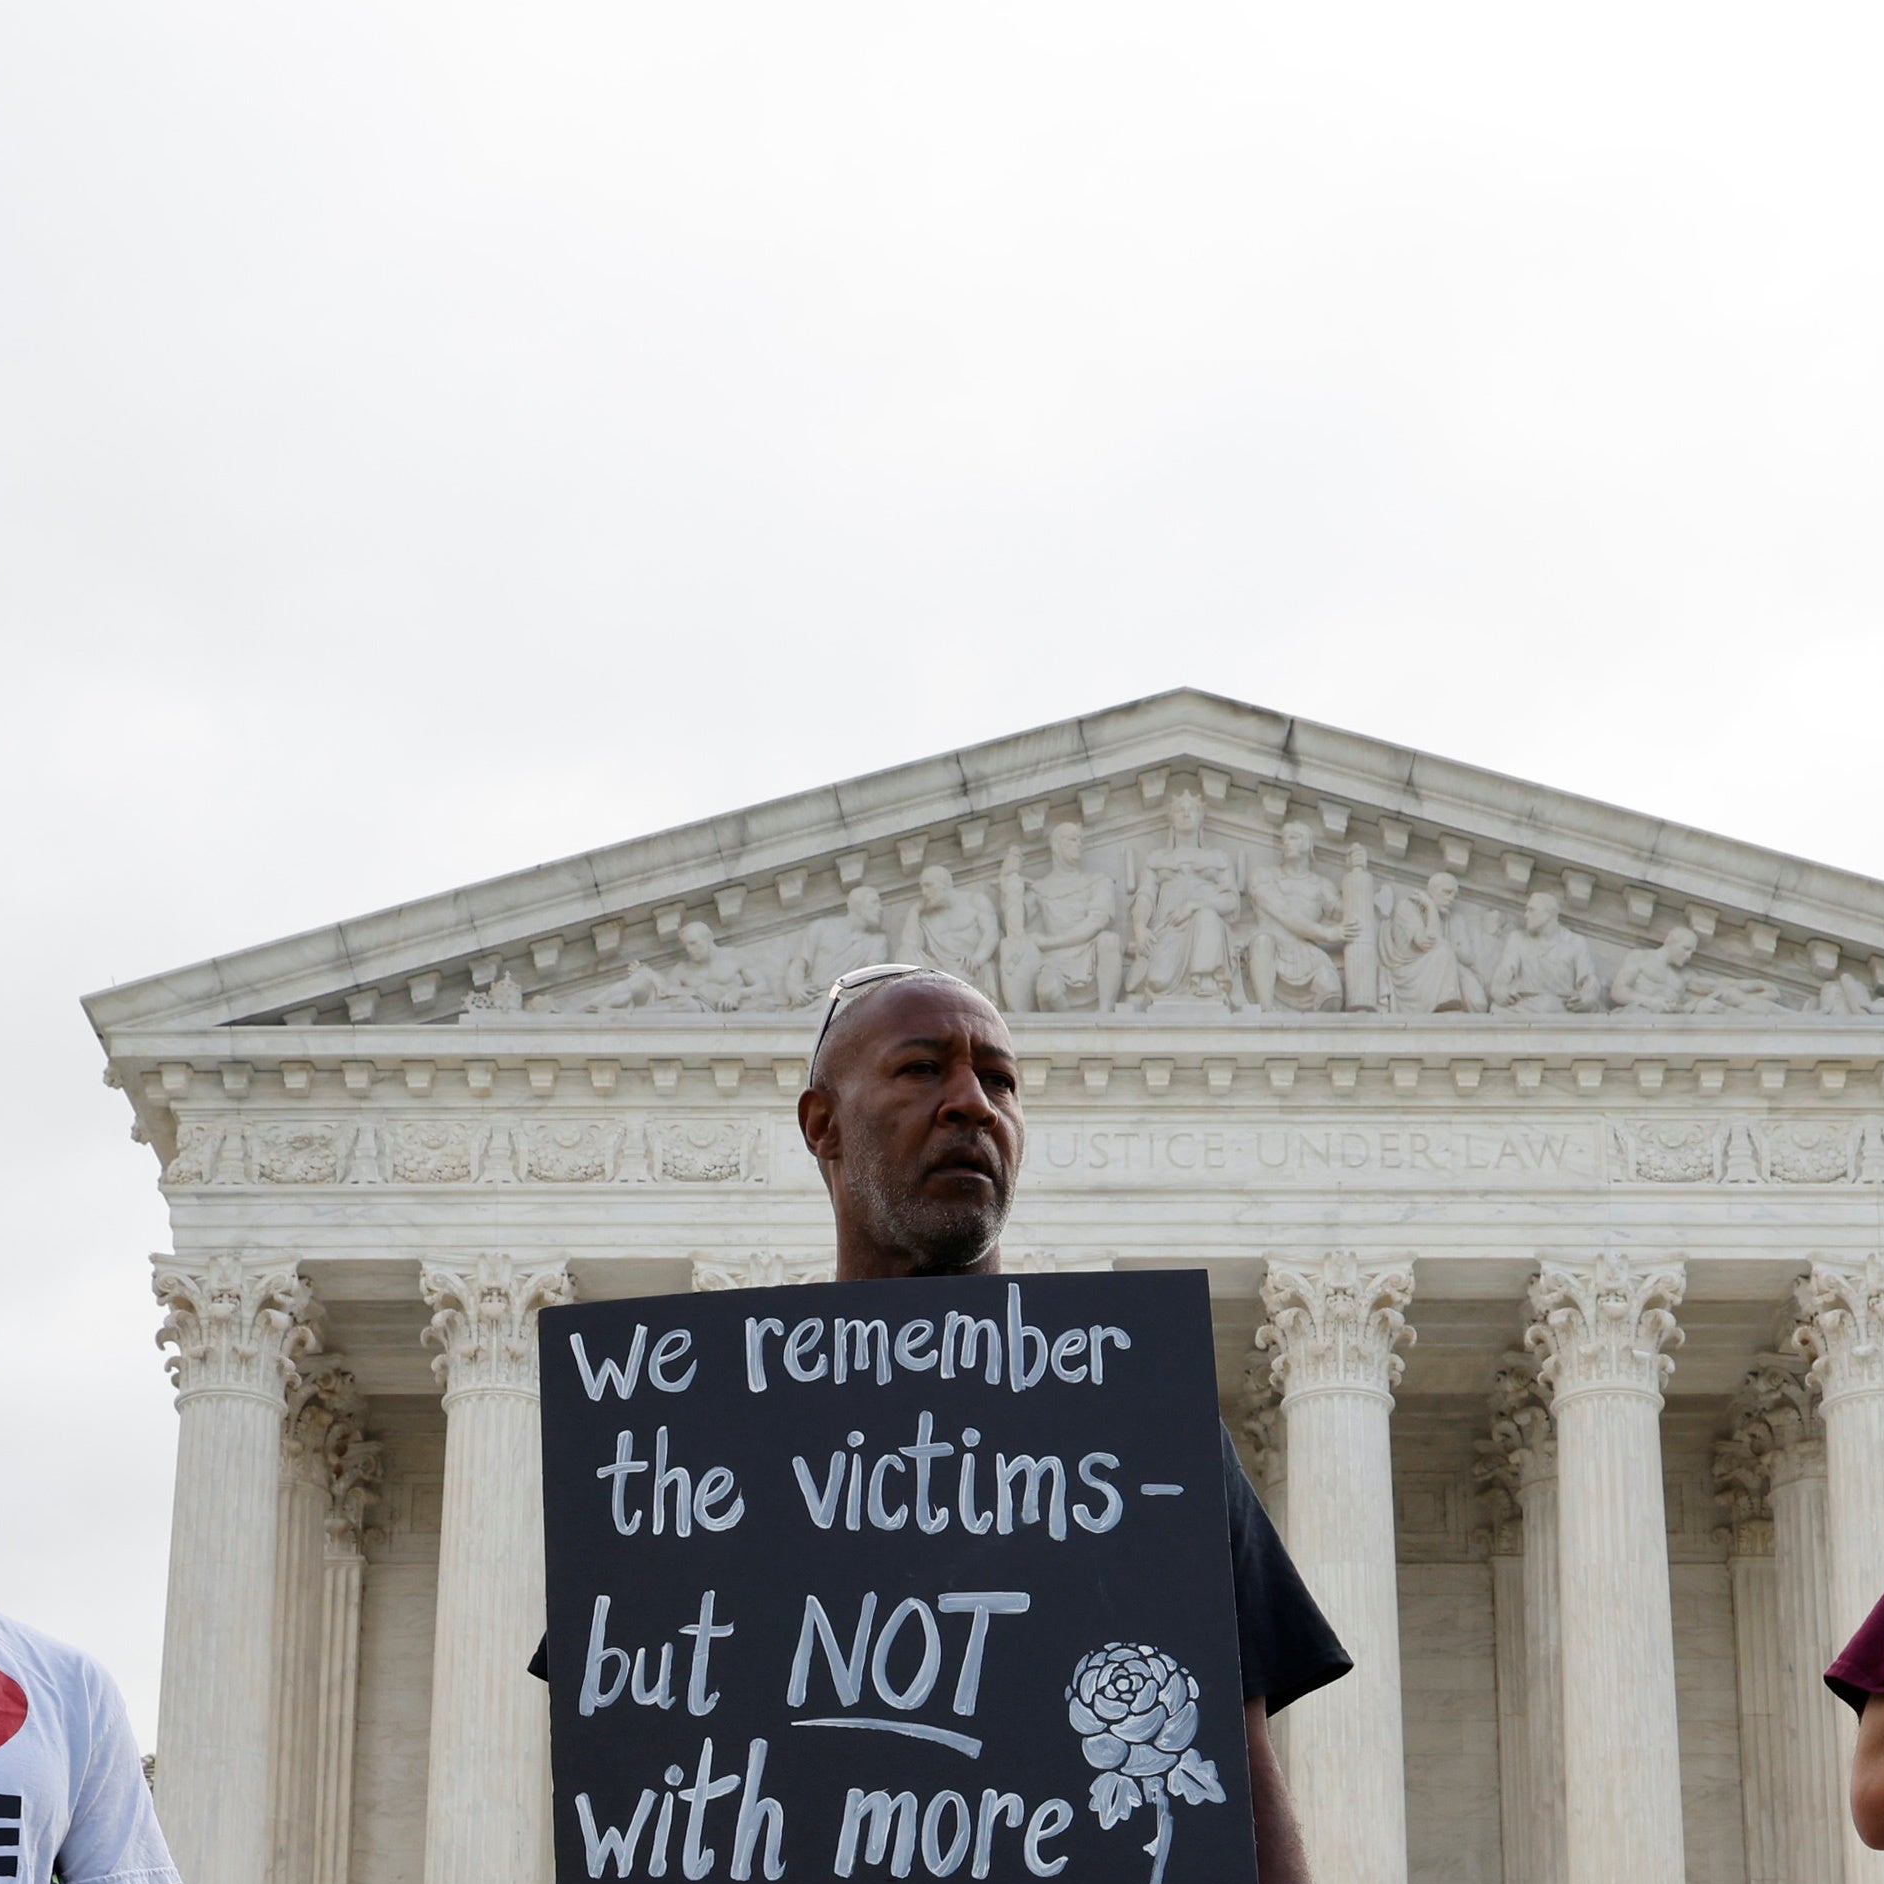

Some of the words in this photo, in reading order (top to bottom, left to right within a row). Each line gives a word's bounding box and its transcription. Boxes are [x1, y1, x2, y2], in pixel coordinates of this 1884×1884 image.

[1256, 1132, 1440, 1168] UNDER
[1464, 1132, 1572, 1168] LAW
[746, 1283, 1132, 1392] remember
[596, 1425, 746, 1537] the
[578, 1590, 734, 1718] but
[786, 1591, 1030, 1717] NOT
[575, 1739, 787, 1881] with
[836, 1786, 1074, 1880] more
